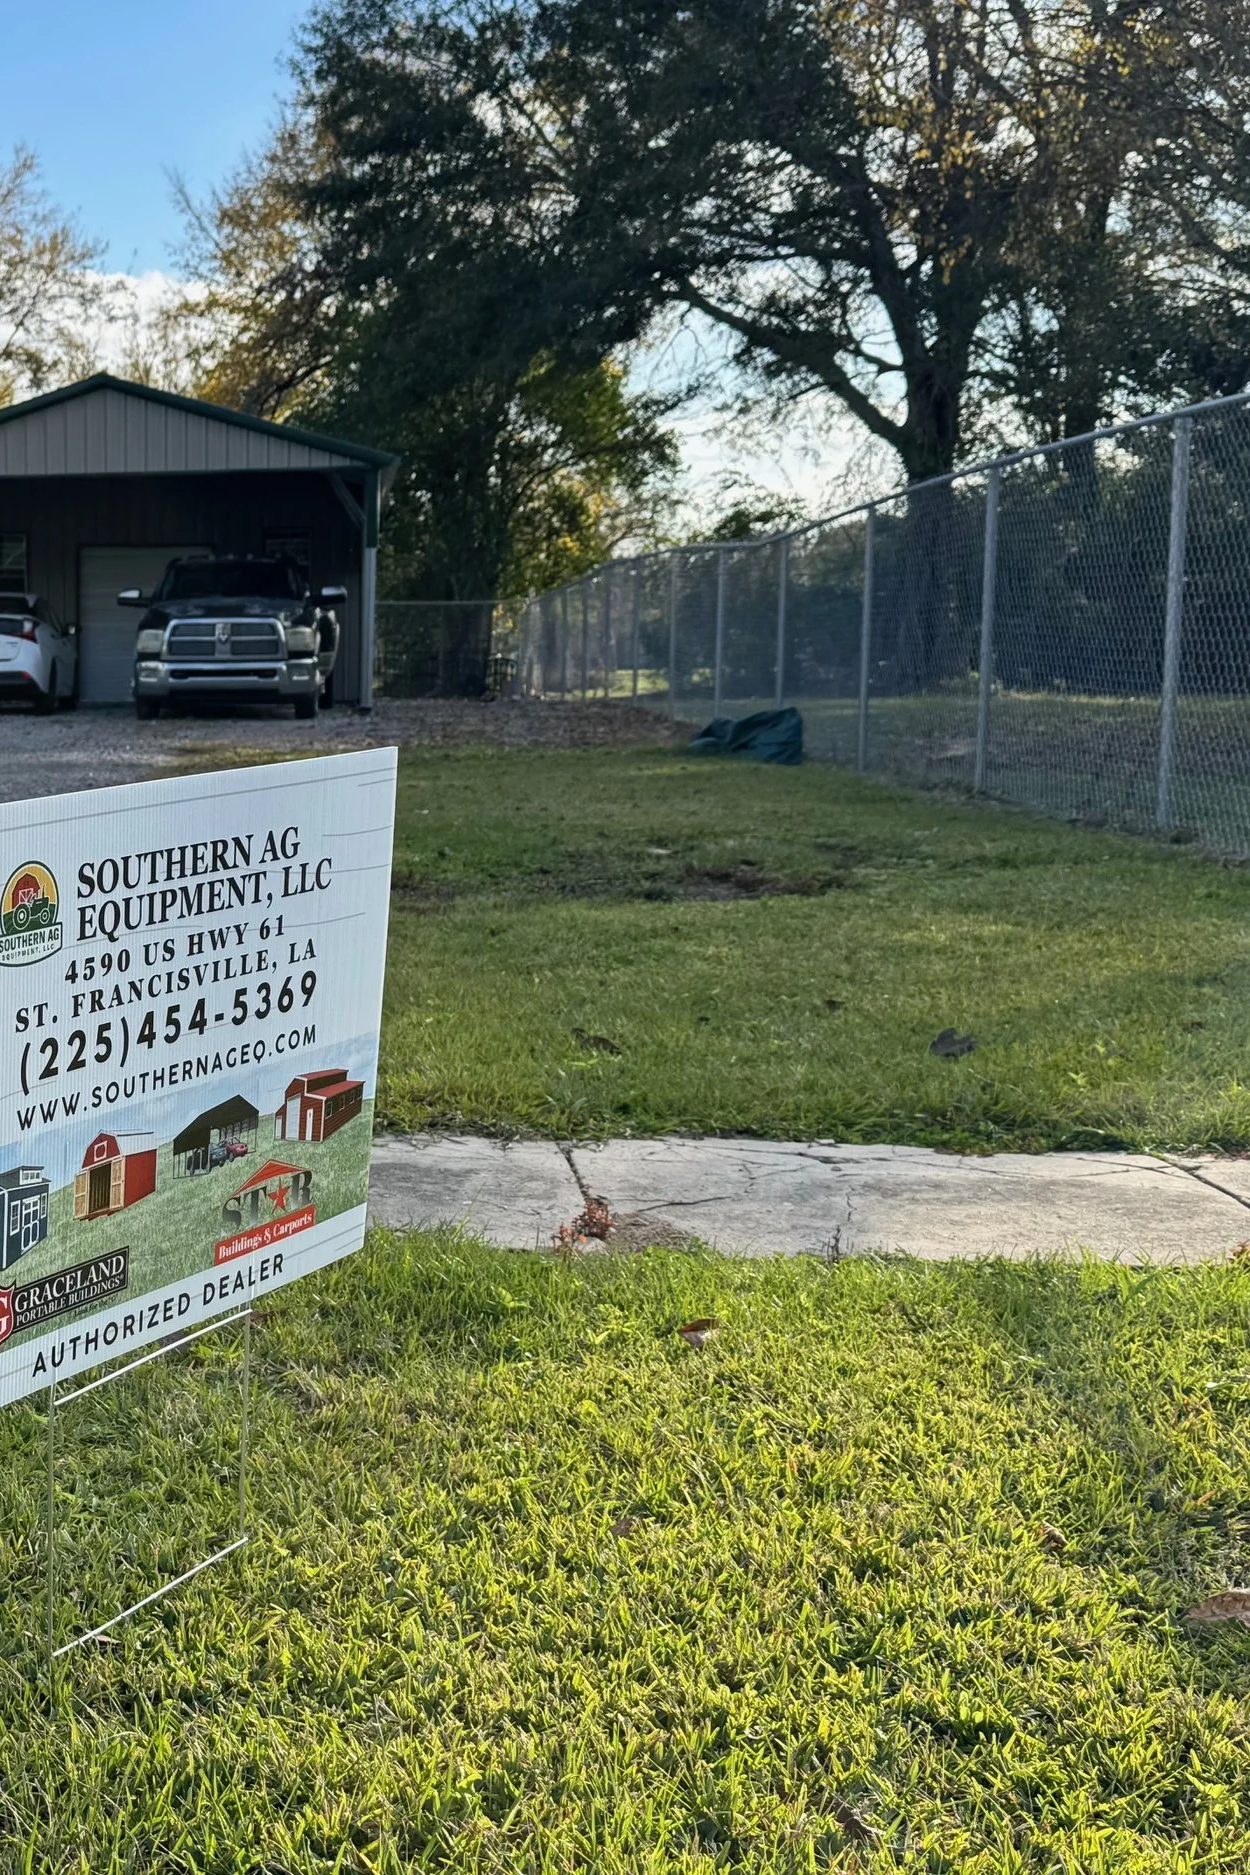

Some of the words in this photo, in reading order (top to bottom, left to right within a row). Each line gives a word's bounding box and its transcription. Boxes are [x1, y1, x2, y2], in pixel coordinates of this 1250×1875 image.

[77, 834, 254, 899] SOUTHERN
[259, 826, 300, 863] AG
[48, 927, 60, 942] AG
[77, 871, 273, 942] EQUIPMENT,
[281, 858, 332, 897] LLC
[2, 946, 41, 961] EQUIPMENT,
[43, 943, 55, 952] LLC
[65, 949, 130, 984] 4590
[143, 938, 175, 966] US
[187, 922, 249, 956] HWY
[259, 914, 285, 940] 61
[15, 1002, 58, 1033] ST.
[71, 949, 277, 1018] FRANCISVILLE,
[288, 938, 317, 965] LA
[20, 970, 317, 1095] (225)454-5369
[17, 1024, 316, 1131] WWW.SOUTHERNAGEQ.COM
[219, 1234, 263, 1259] Buildings
[273, 1213, 313, 1237] Carports
[14, 1255, 125, 1312] GRACELAND
[16, 1295, 67, 1326] PORTABLE
[32, 1292, 190, 1377] AUTHORIZED
[203, 1253, 284, 1306] DEALER
